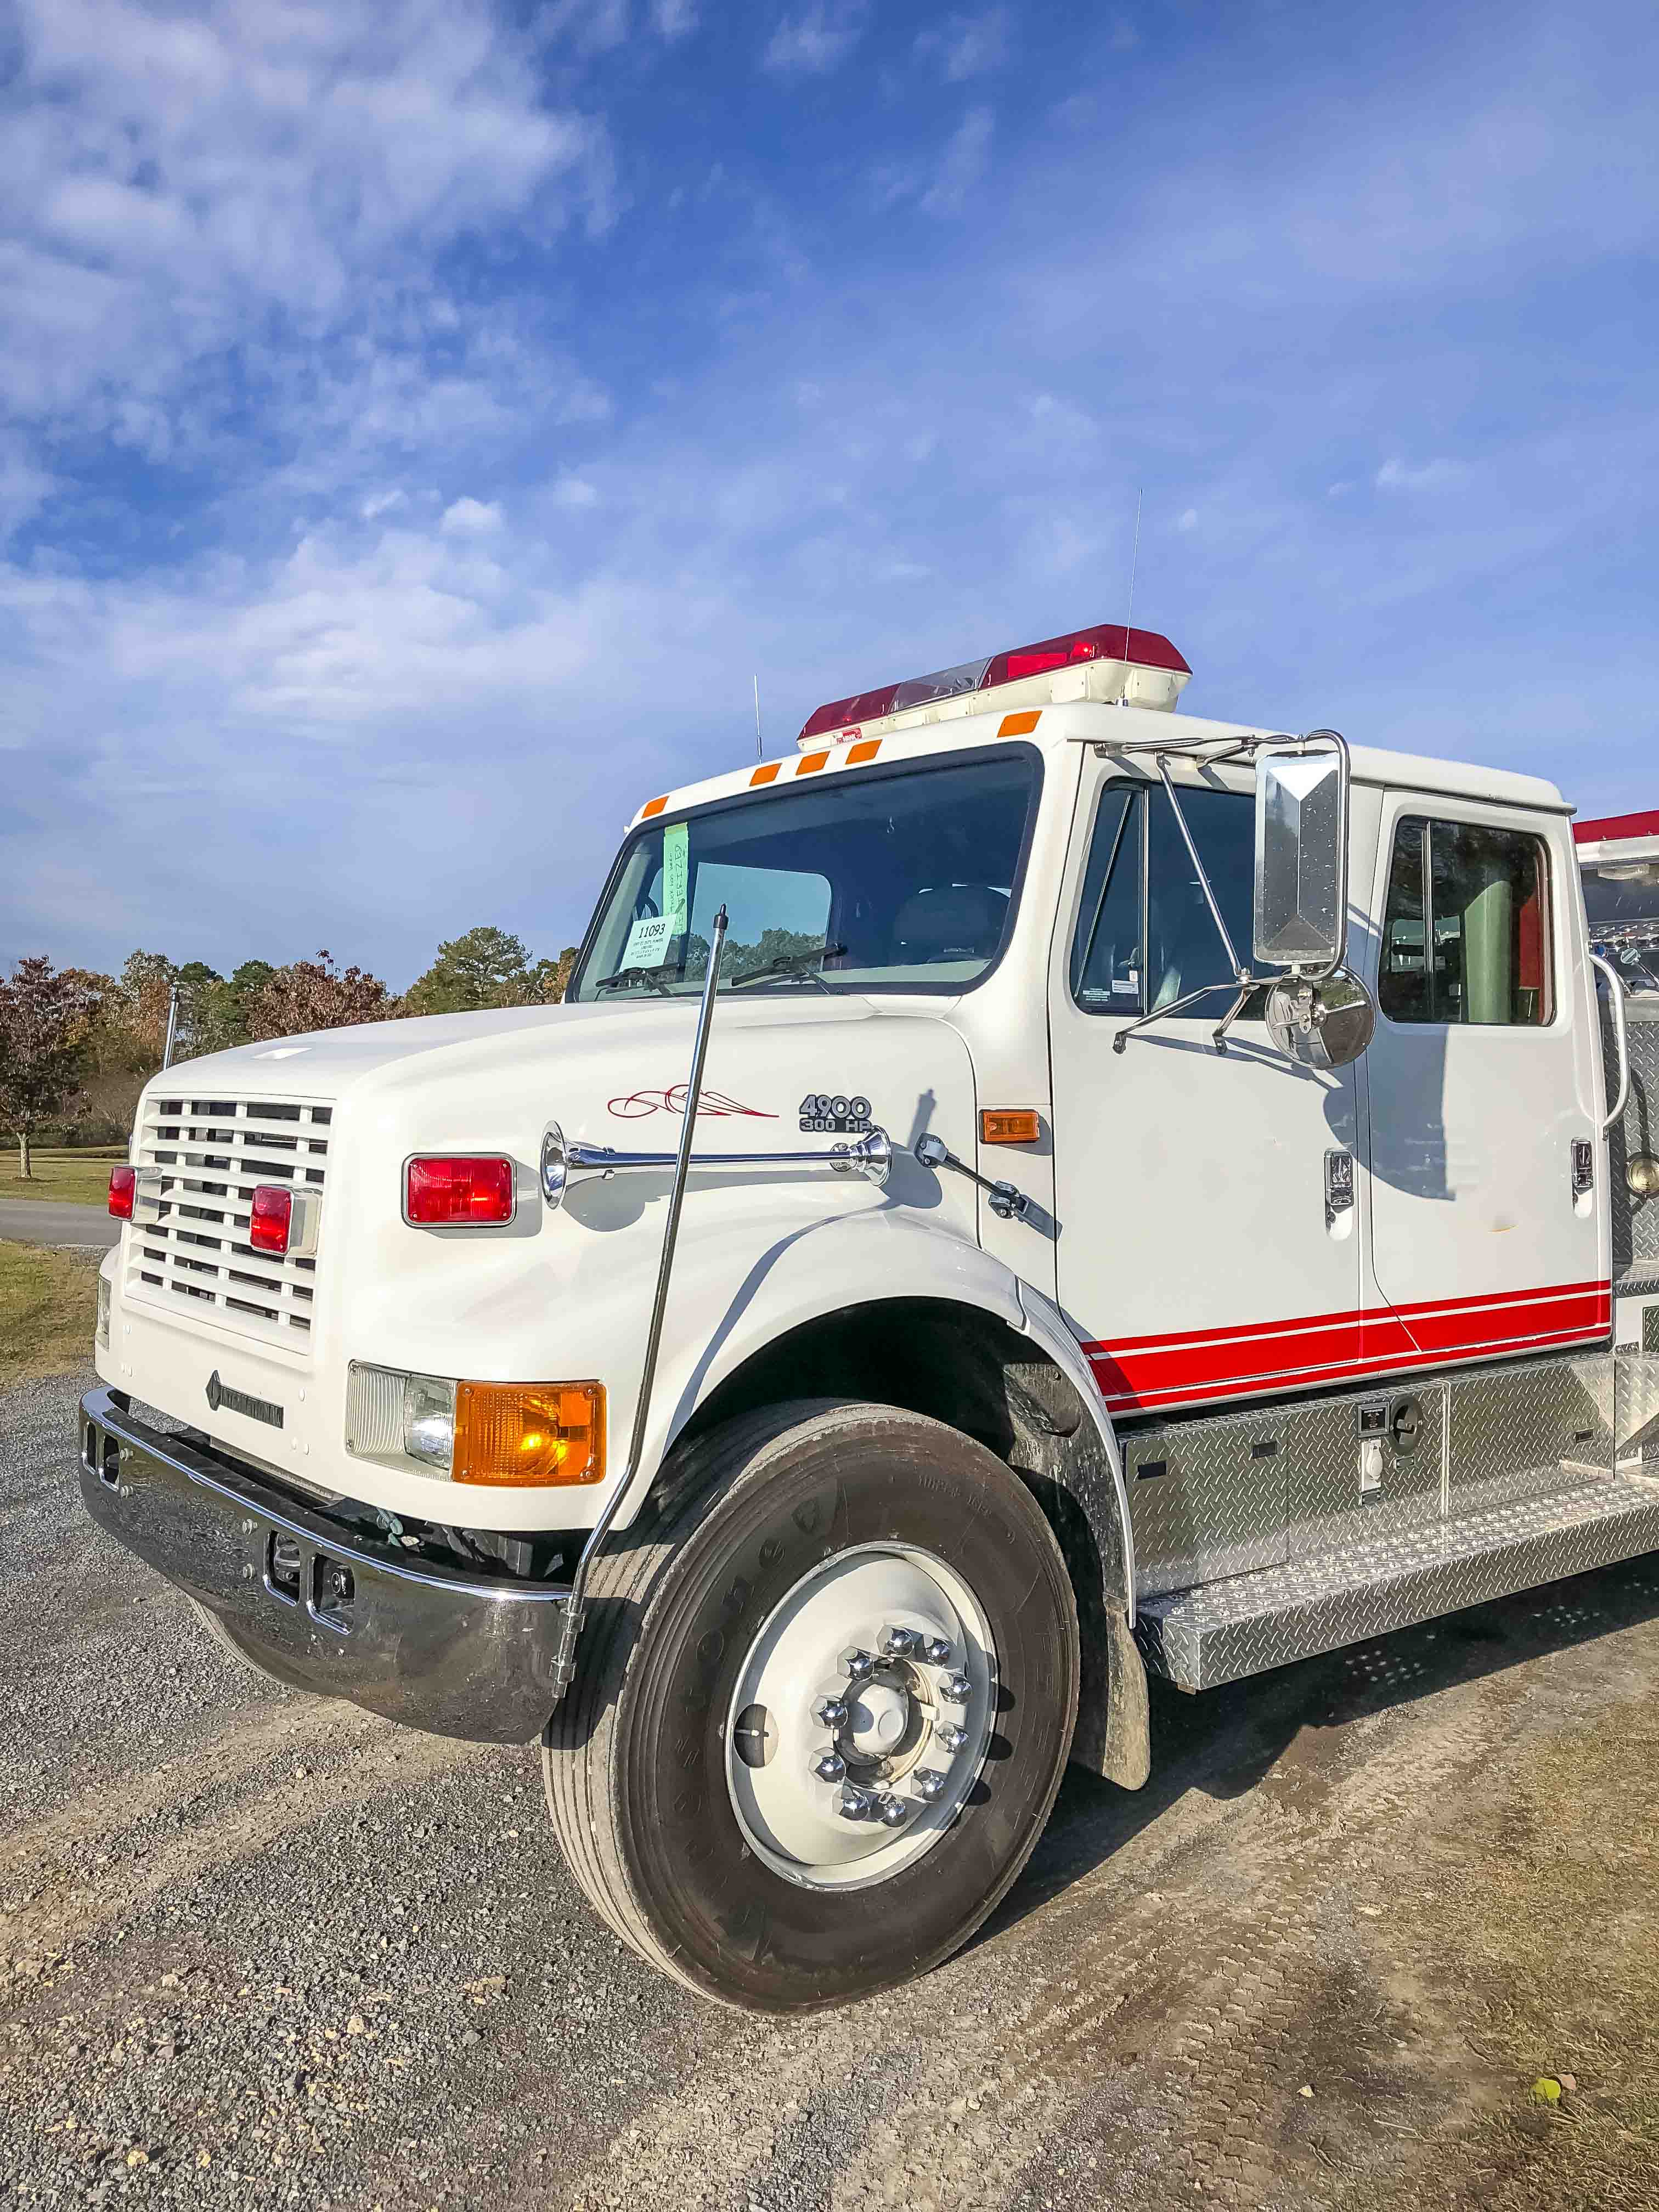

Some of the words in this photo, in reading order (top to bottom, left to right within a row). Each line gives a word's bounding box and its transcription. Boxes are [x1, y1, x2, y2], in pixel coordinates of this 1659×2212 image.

[639, 923, 665, 938] 11093
[799, 1094, 872, 1119] 4900
[800, 1119, 836, 1131] 300
[845, 1120, 872, 1132] HP
